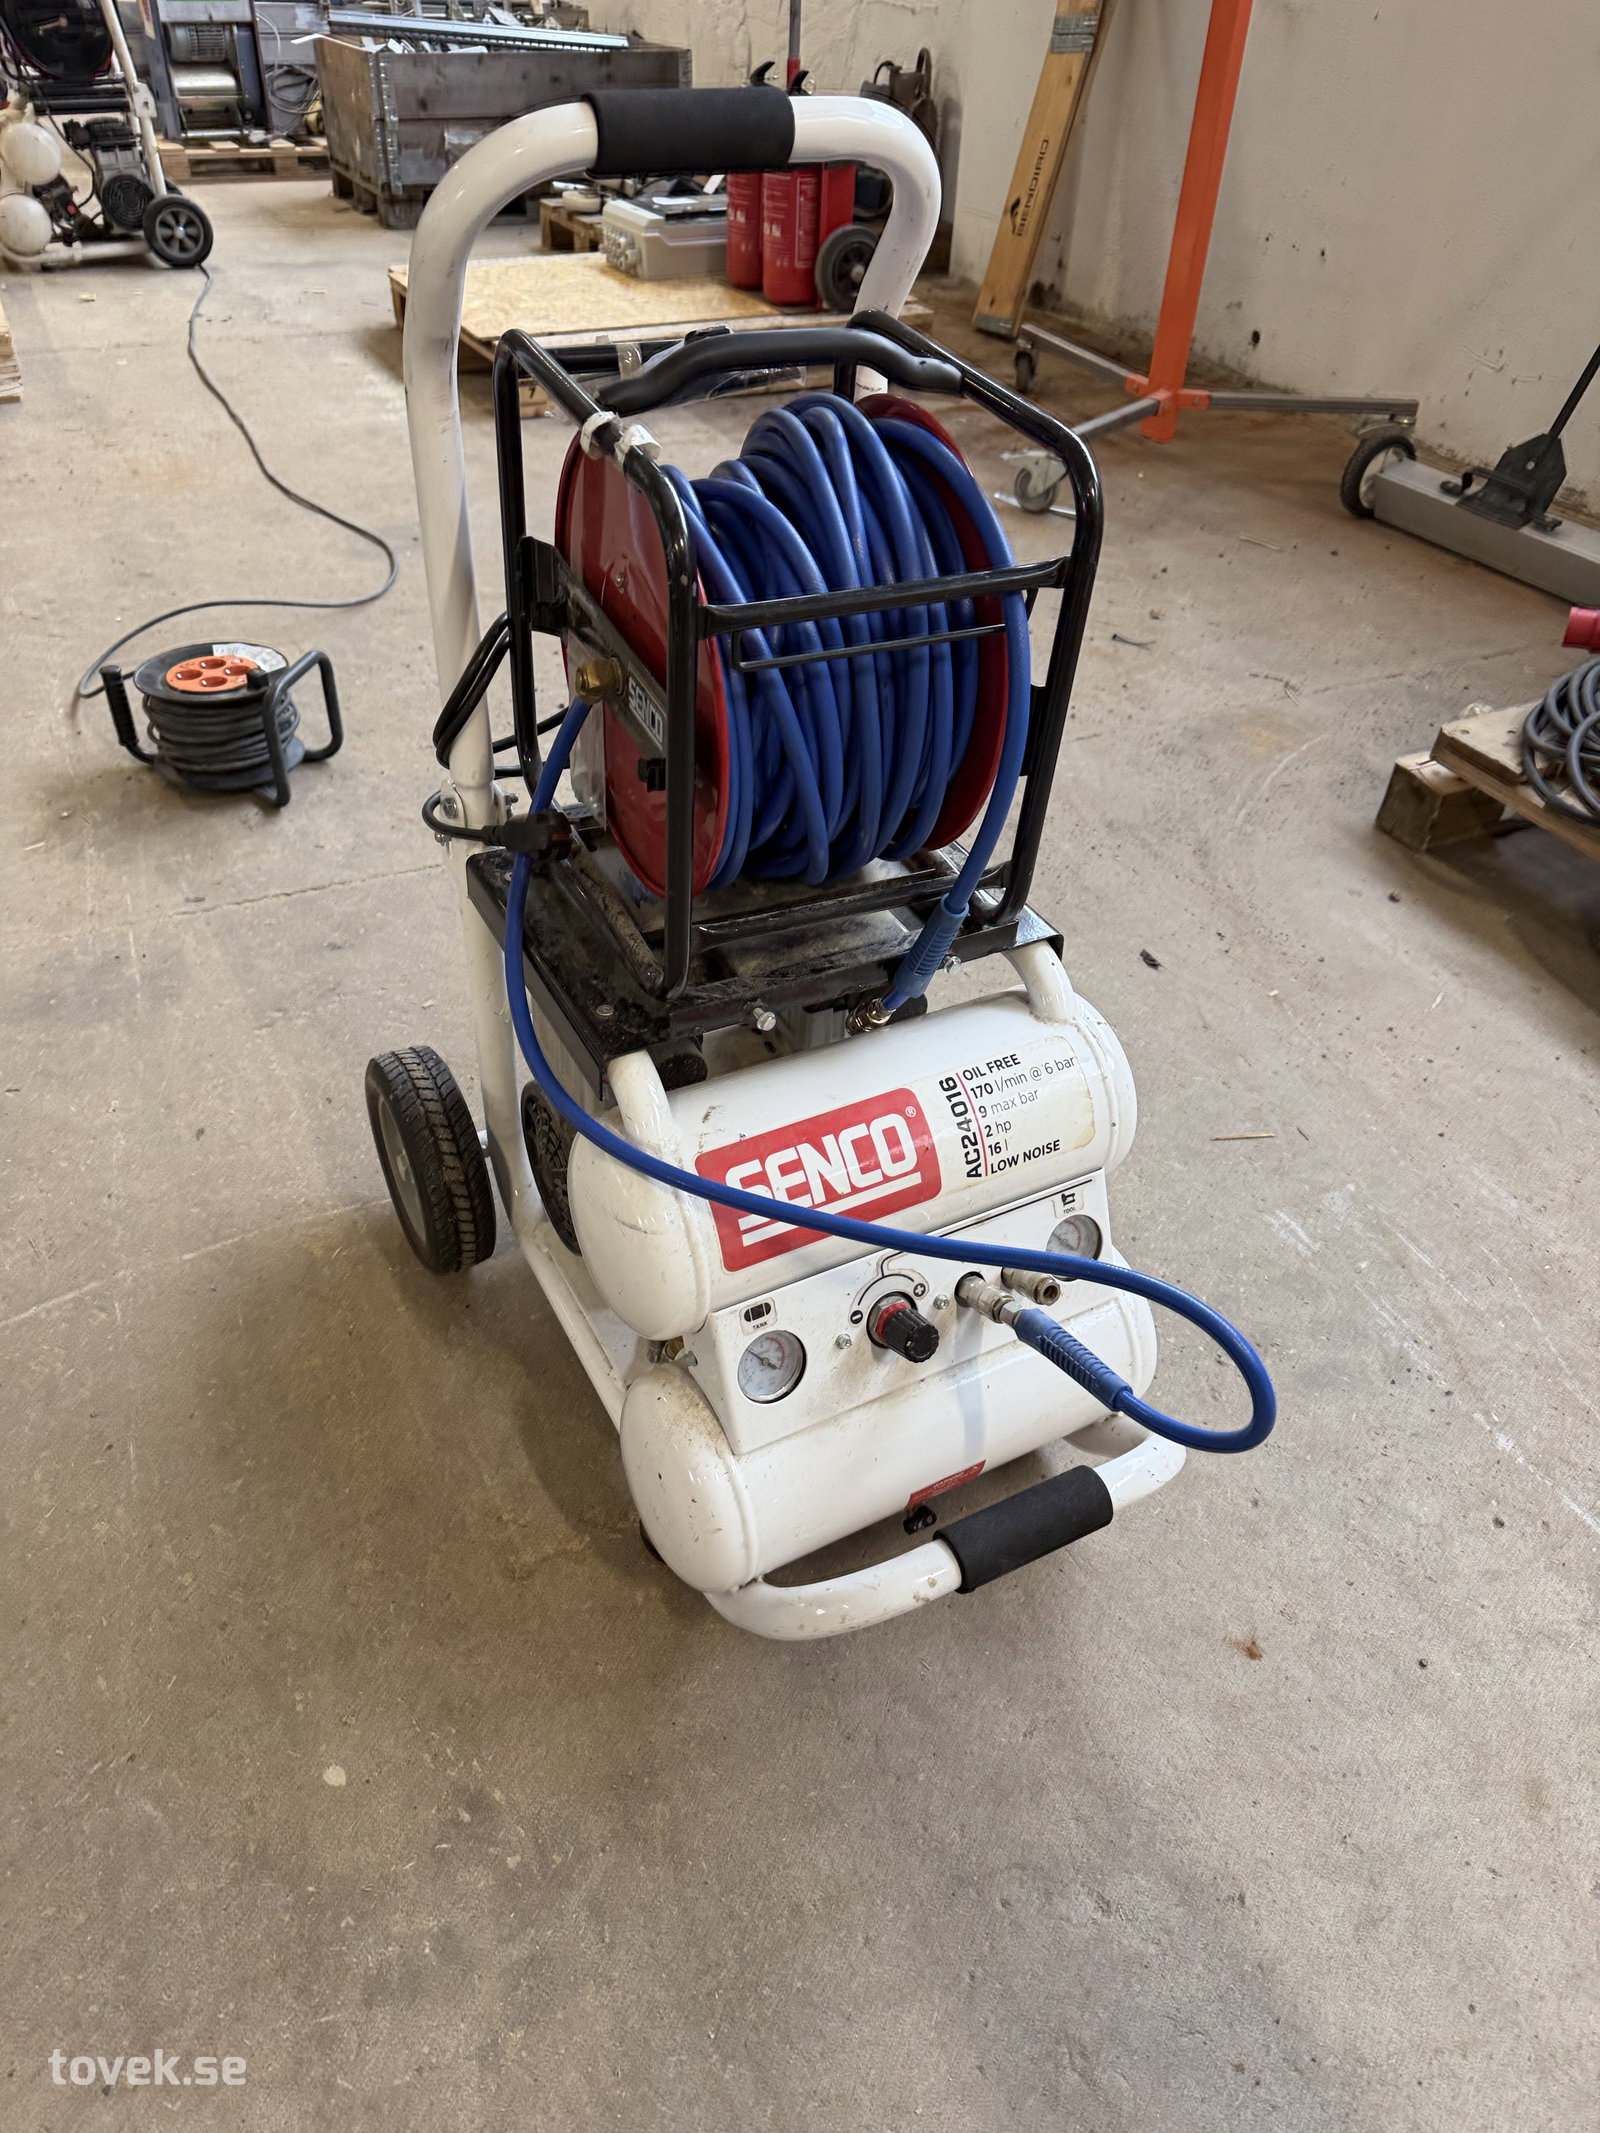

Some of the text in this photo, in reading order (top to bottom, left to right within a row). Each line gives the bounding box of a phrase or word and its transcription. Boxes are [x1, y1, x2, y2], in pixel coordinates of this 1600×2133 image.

[962, 1053, 1021, 1081] OIL FREE
[970, 1082, 994, 1099] 170
[1029, 1066, 1042, 1081] @
[1044, 1062, 1054, 1075] 6
[1054, 1056, 1075, 1071] bar
[978, 1088, 1039, 1118] 9 max bar
[939, 1076, 982, 1178] AC24016
[984, 1120, 1012, 1138] 2 hp
[988, 1141, 1002, 1156] 16
[990, 1139, 1061, 1175] LOW NOISE
[752, 1321, 769, 1331] TANK
